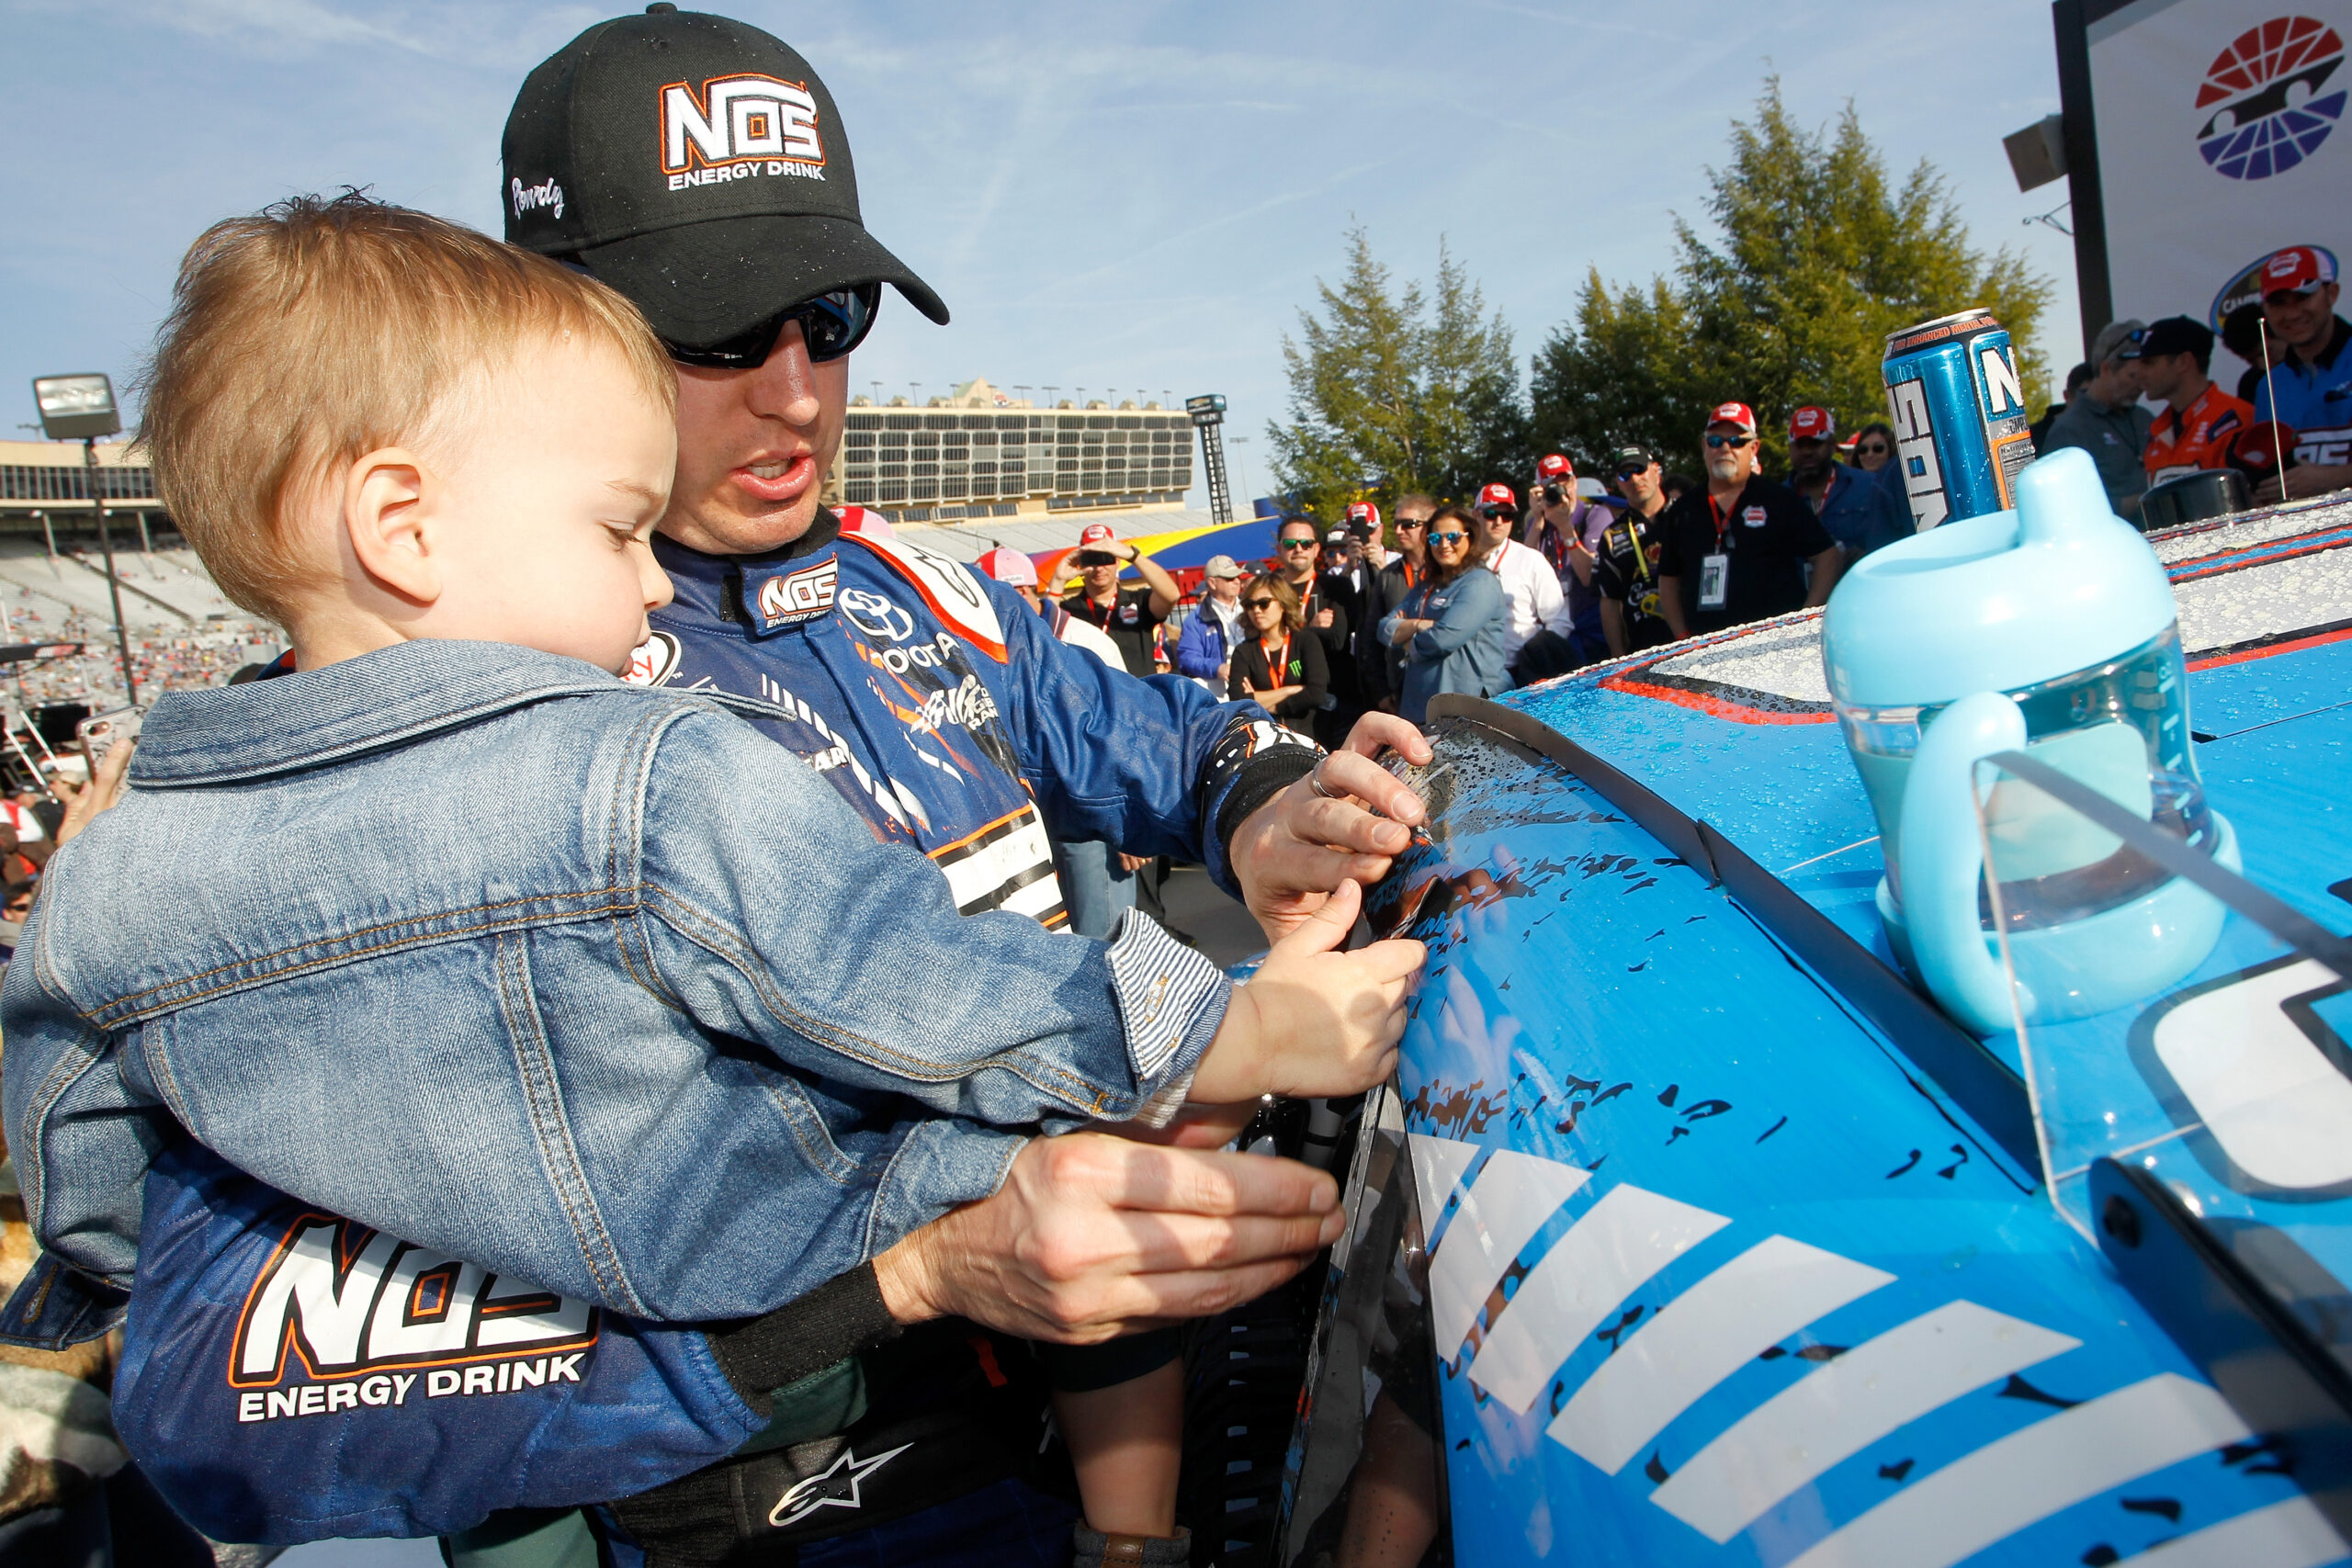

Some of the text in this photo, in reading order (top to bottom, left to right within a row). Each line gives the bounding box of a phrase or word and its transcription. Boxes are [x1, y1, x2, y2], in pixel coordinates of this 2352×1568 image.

[665, 79, 824, 167] NOS
[669, 161, 826, 191] ENERGY DRINK
[1906, 326, 1951, 347] ENHANCED
[761, 558, 839, 616] NOS
[766, 612, 809, 629] ENERGY
[241, 1222, 597, 1377] NOS
[238, 1351, 585, 1423] ENERGY DRINK
